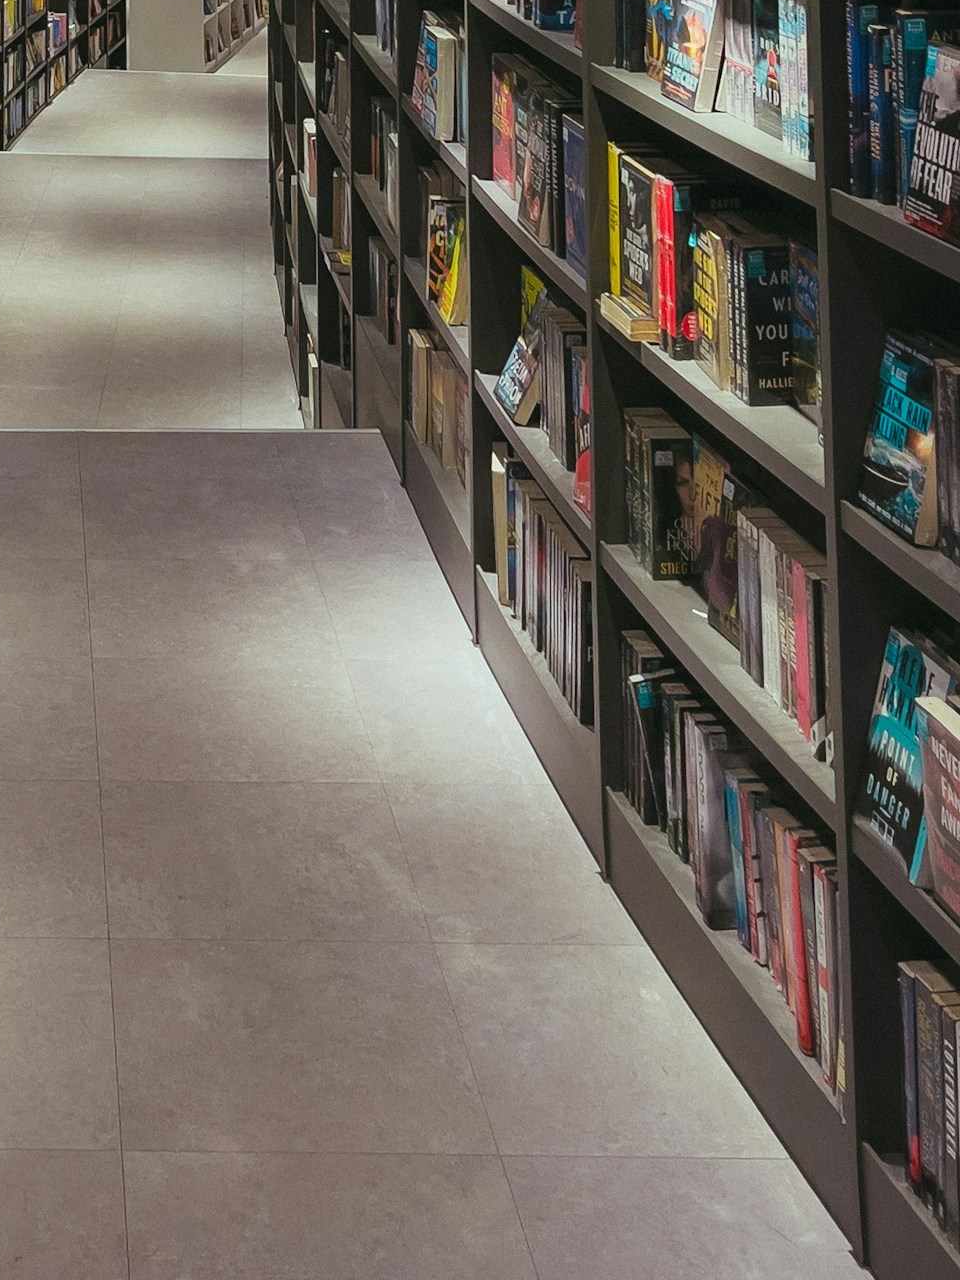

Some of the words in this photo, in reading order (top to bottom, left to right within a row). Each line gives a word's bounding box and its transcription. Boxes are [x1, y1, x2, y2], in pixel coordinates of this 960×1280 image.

[670, 66, 699, 92] SECRET
[910, 158, 924, 191] OF
[924, 163, 952, 205] FEAR
[755, 325, 788, 340] YOU
[759, 378, 794, 389] HALLIE
[878, 385, 903, 420] LACK
[906, 401, 931, 436] RAIN
[875, 412, 905, 451] ALLING
[706, 473, 719, 492] THE
[694, 483, 720, 517] FIFT
[661, 562, 687, 575] STIEG
[883, 730, 915, 775] POINT
[886, 766, 898, 787] OF
[866, 773, 910, 830] DANGER
[944, 1038, 957, 1160] LOVEMURDER
